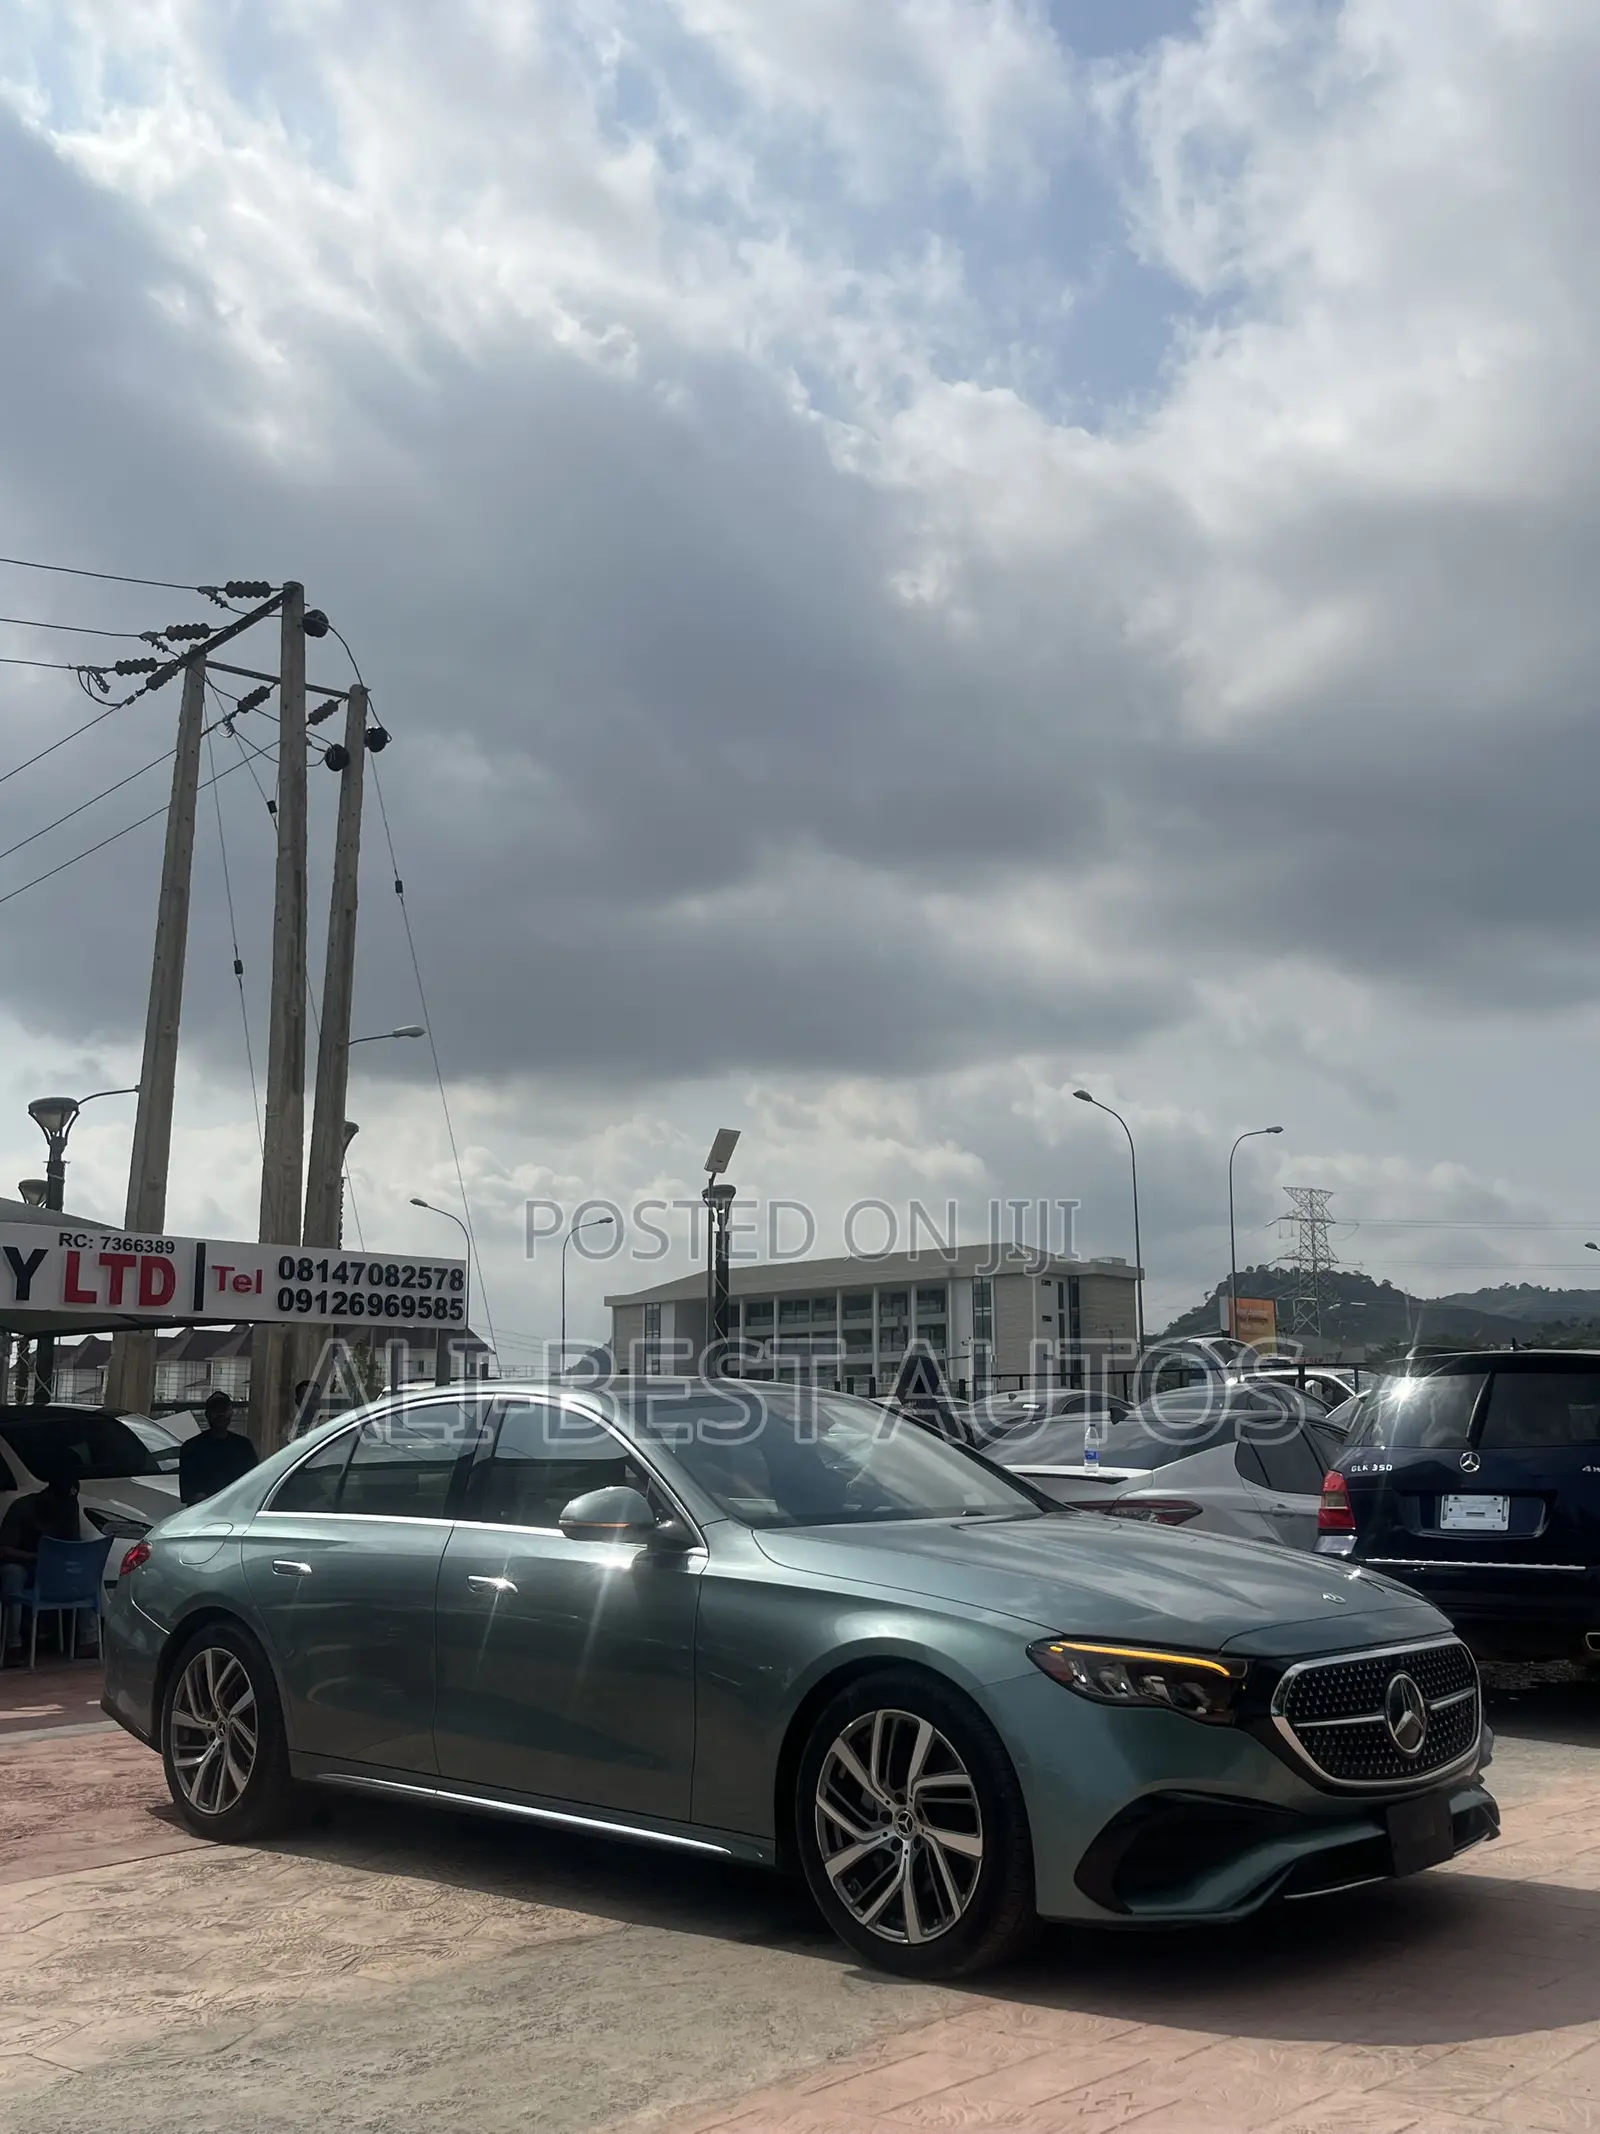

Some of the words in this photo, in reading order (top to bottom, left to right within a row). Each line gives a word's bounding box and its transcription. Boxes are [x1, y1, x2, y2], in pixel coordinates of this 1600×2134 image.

[58, 1232, 93, 1249] RC:
[100, 1236, 175, 1254] 7366389
[0, 1245, 49, 1301] Y
[63, 1250, 176, 1306] LTD
[211, 1265, 263, 1295] Tel
[278, 1255, 465, 1291] 08147082578
[277, 1286, 465, 1321] 09126969585
[1351, 1464, 1369, 1472] GLK
[1371, 1463, 1393, 1471] 350
